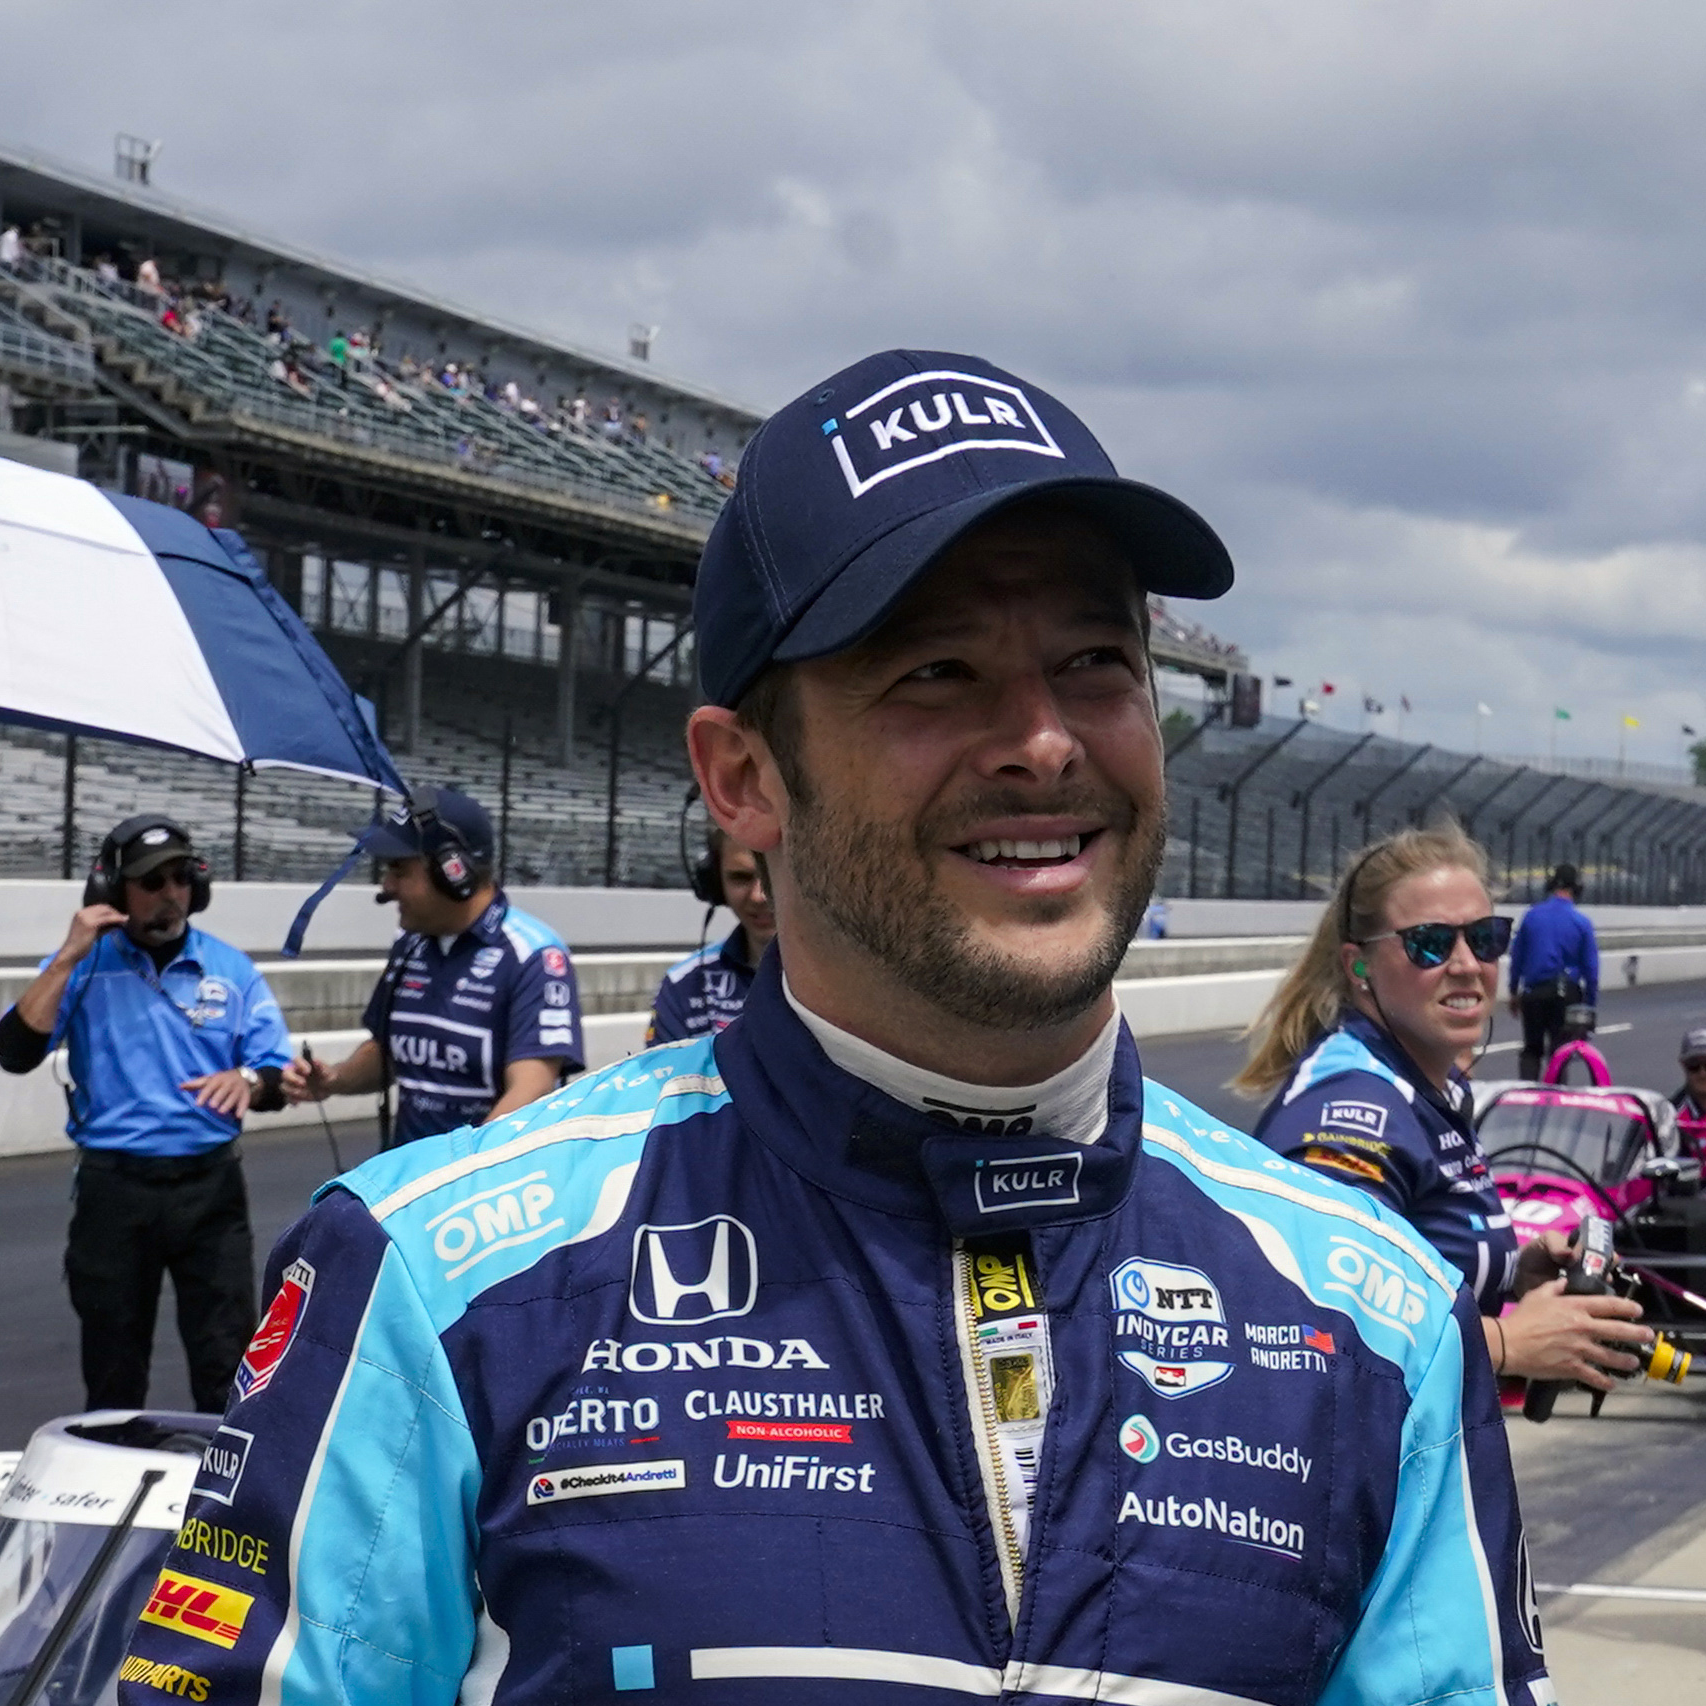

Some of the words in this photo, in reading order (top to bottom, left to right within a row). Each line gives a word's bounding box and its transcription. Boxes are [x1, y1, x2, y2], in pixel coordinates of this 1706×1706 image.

[870, 392, 1026, 449] KULR
[1333, 1108, 1376, 1125] KULR
[994, 1170, 1063, 1193] KULR
[433, 1182, 556, 1263] OMP
[976, 1254, 1021, 1311] OMP
[1155, 1287, 1212, 1309] NTT
[1326, 1246, 1425, 1326] OMP
[1116, 1314, 1229, 1347] INDYCAR
[1244, 1322, 1300, 1344] MARCO
[580, 1335, 829, 1378] HONDA
[1140, 1339, 1203, 1359] SERIES
[1250, 1346, 1328, 1373] ANDRETTI
[684, 1390, 887, 1421] CLAUSTHALER
[202, 1445, 239, 1480] KULR
[713, 1454, 877, 1493] UniFirst
[1165, 1431, 1313, 1484] GasBuddy
[49, 1490, 116, 1509] safer
[1117, 1492, 1304, 1550] AutoNation
